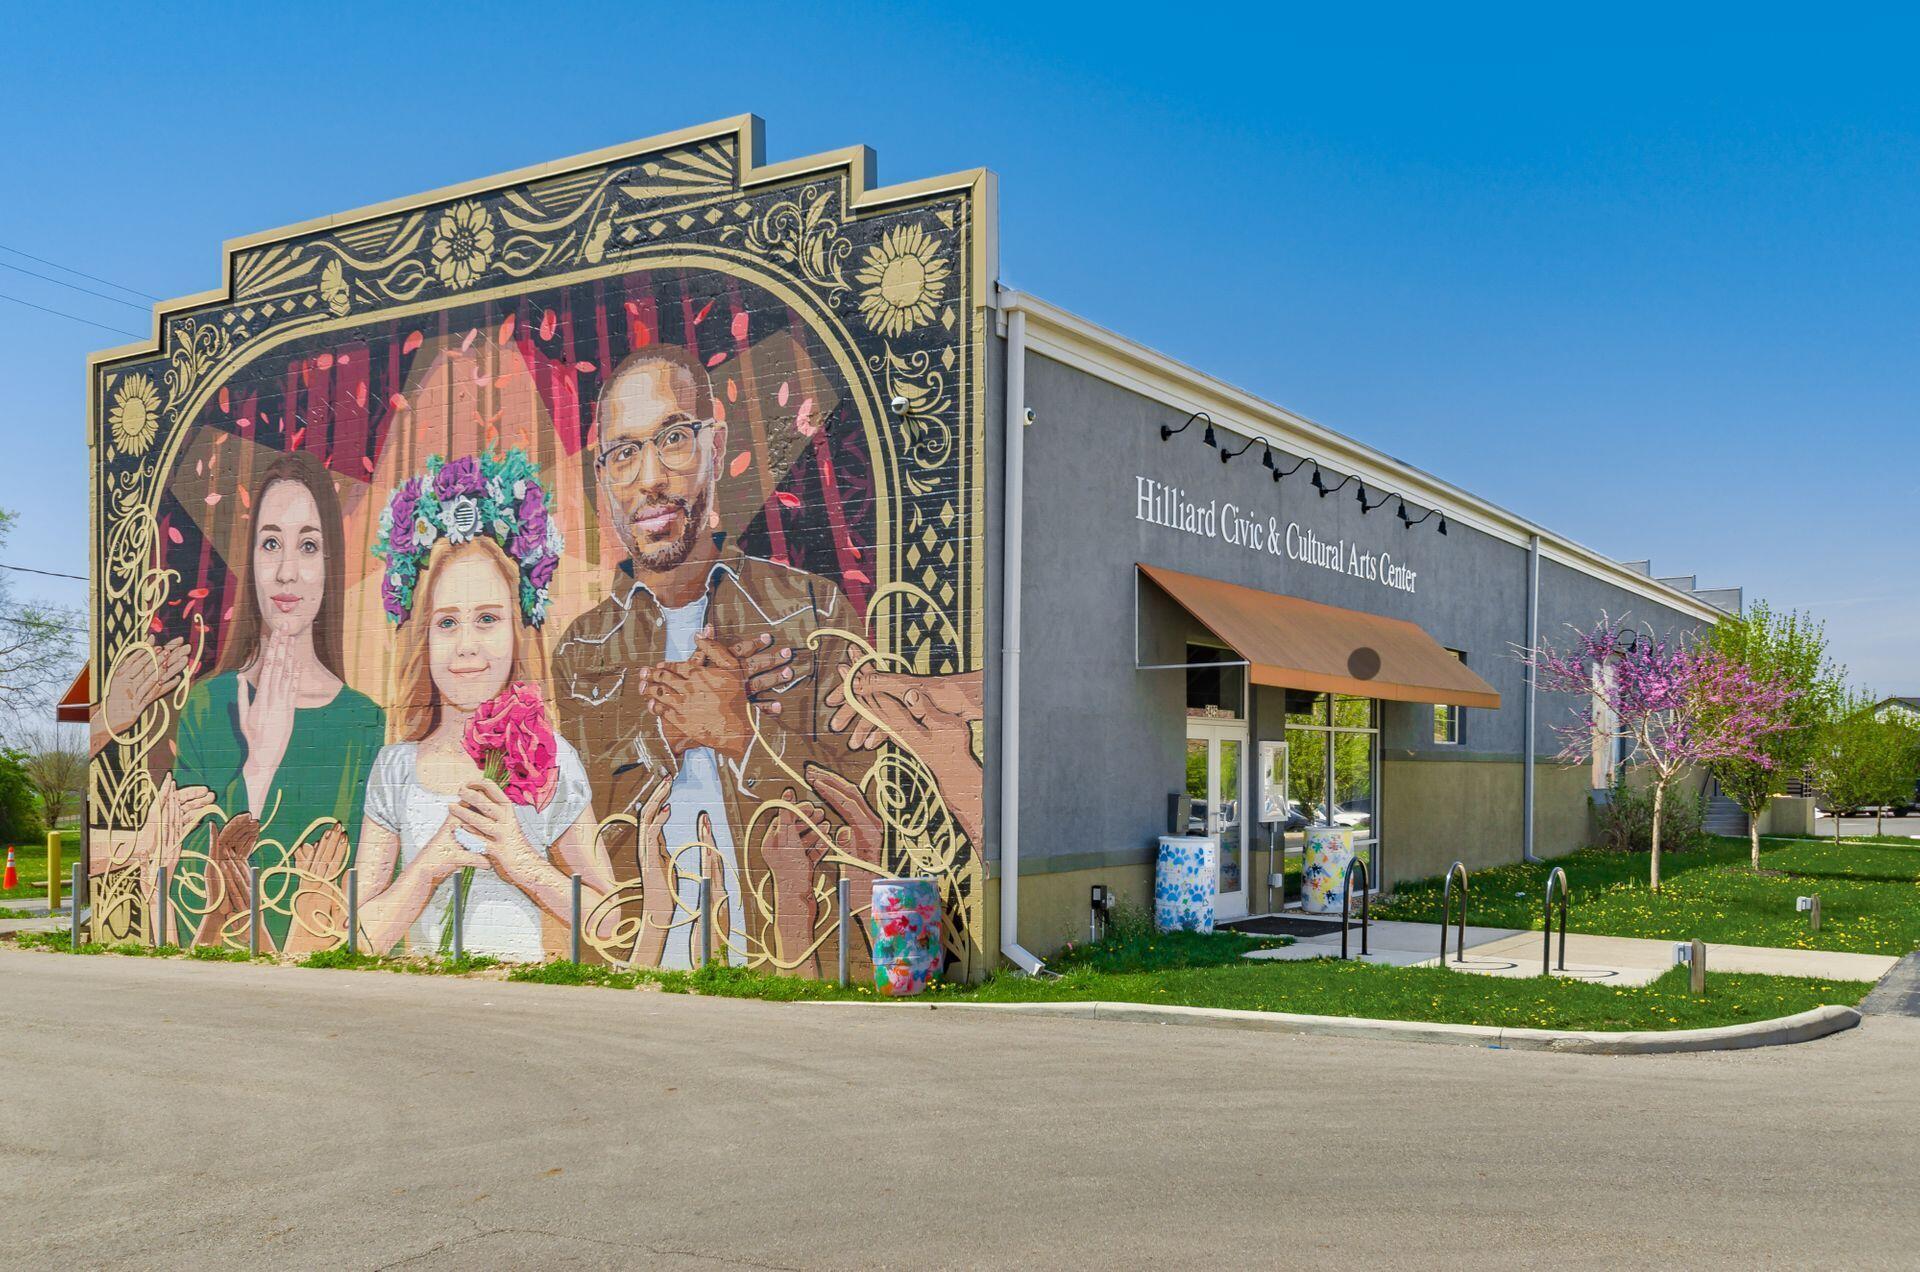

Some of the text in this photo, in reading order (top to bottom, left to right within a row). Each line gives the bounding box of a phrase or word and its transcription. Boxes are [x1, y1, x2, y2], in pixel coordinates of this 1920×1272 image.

[1135, 475, 1417, 594] Hilliard Civic & Cultural Arts Center
